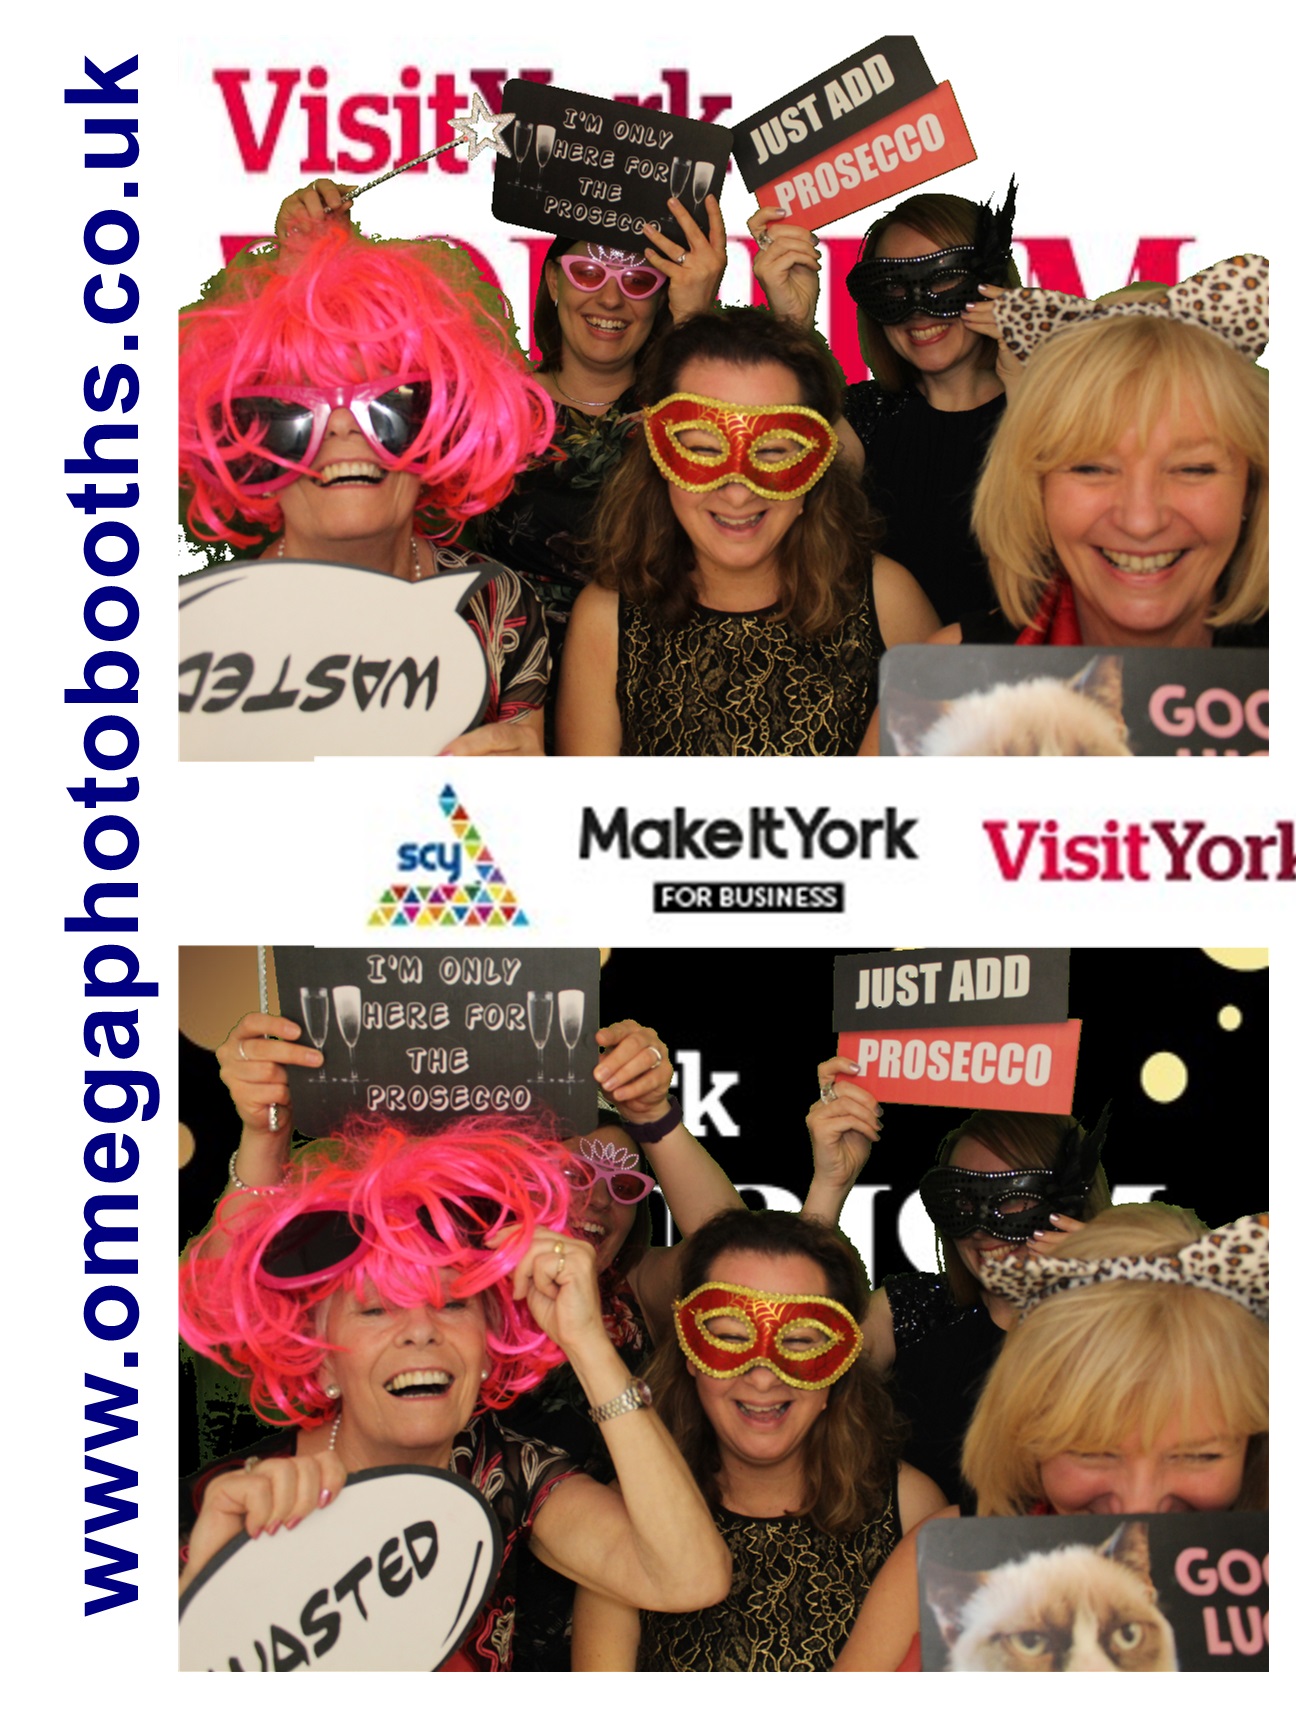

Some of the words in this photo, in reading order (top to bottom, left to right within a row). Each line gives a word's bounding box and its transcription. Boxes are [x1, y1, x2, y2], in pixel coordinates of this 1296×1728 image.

[563, 108, 603, 135] I'M
[613, 120, 674, 150] ONLY
[749, 94, 823, 164] JUST
[828, 53, 895, 121] ADD
[553, 139, 615, 169] HERE
[625, 156, 669, 183] FOR
[773, 112, 946, 217] PROSECCO
[579, 177, 622, 202] THE
[366, 955, 423, 985] I'M
[439, 956, 522, 986] ONLY
[855, 962, 942, 1010] JUST
[948, 954, 1030, 1002] ADD
[363, 1002, 450, 1030] HERE
[465, 1003, 527, 1031] FOR
[407, 1047, 469, 1074] THE
[858, 1038, 1052, 1087] PROSECCO
[367, 1084, 531, 1111] PROSECCO
[1174, 1547, 1269, 1596] GO
[1203, 1606, 1269, 1655] LU
